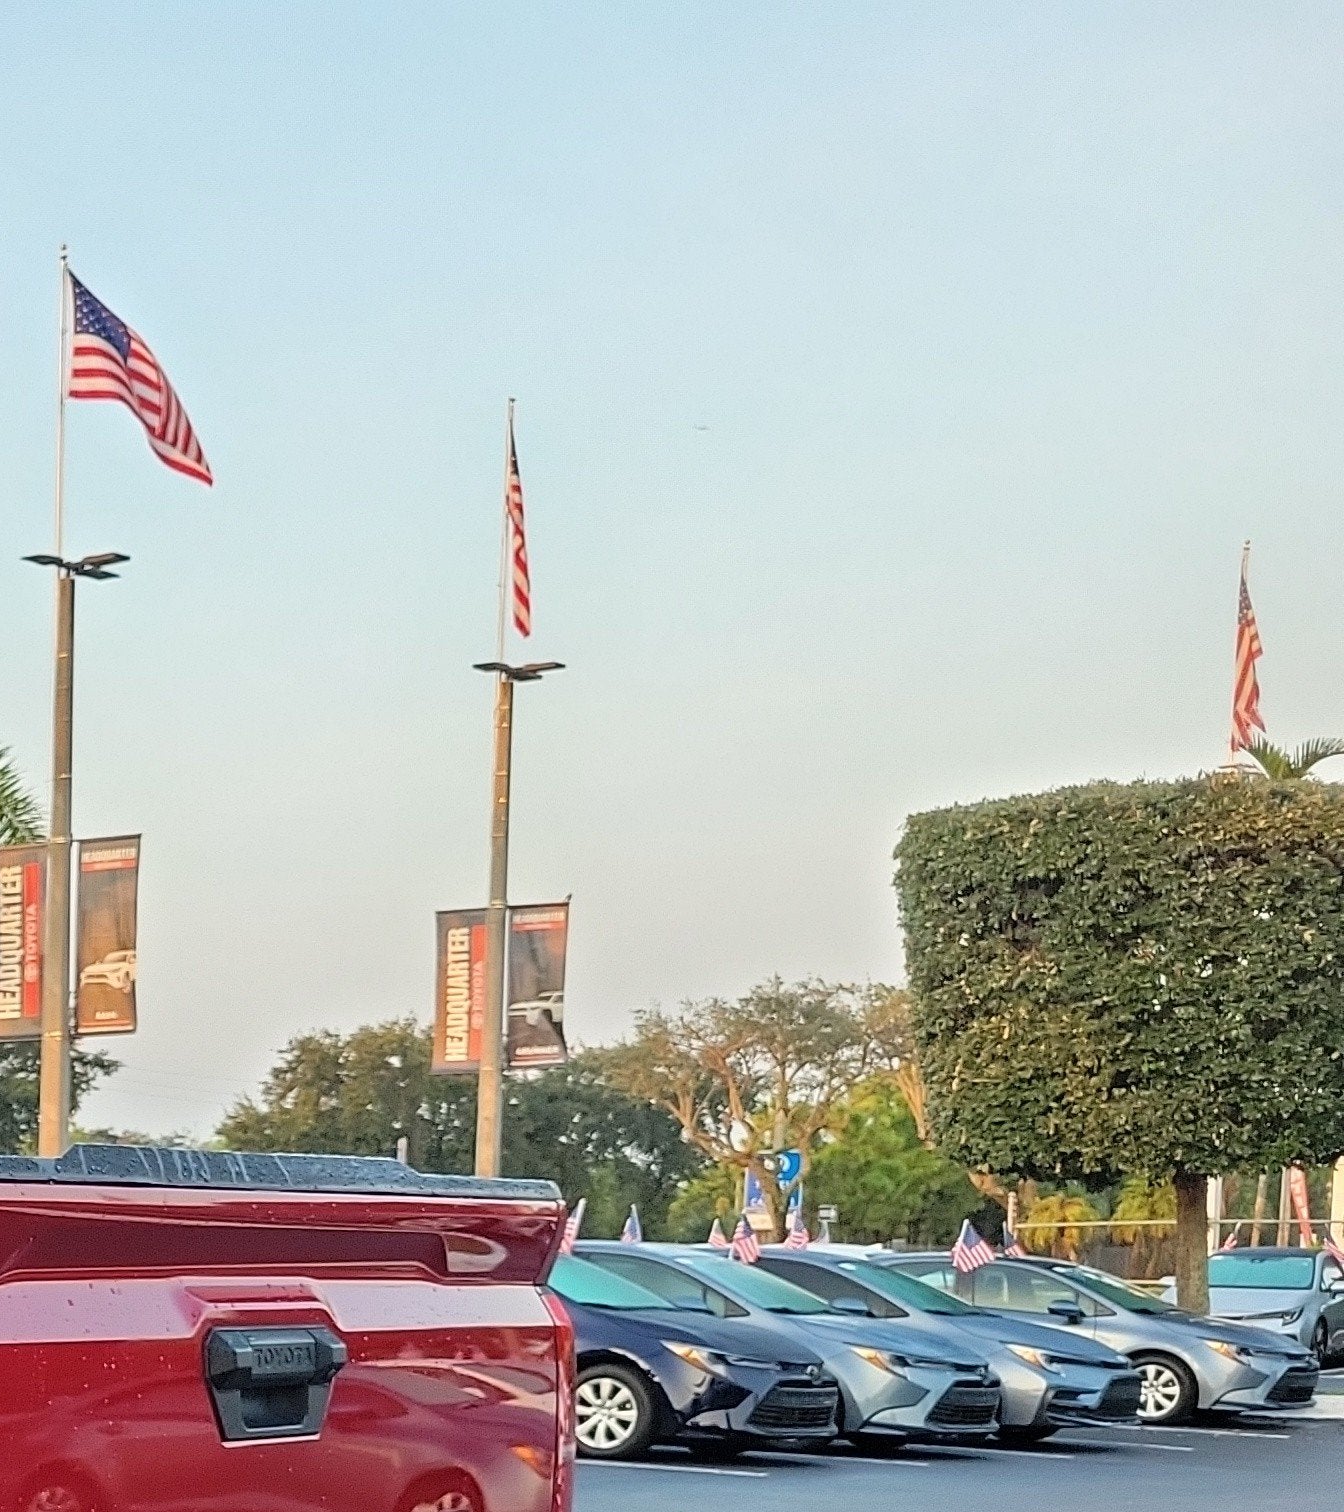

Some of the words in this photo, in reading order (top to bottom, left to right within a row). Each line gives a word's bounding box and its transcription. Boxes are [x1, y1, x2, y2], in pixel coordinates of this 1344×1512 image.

[25, 903, 40, 963] TOYOTA
[444, 927, 471, 1062] HEADQUARTER
[253, 1346, 315, 1369] TOYOTA
